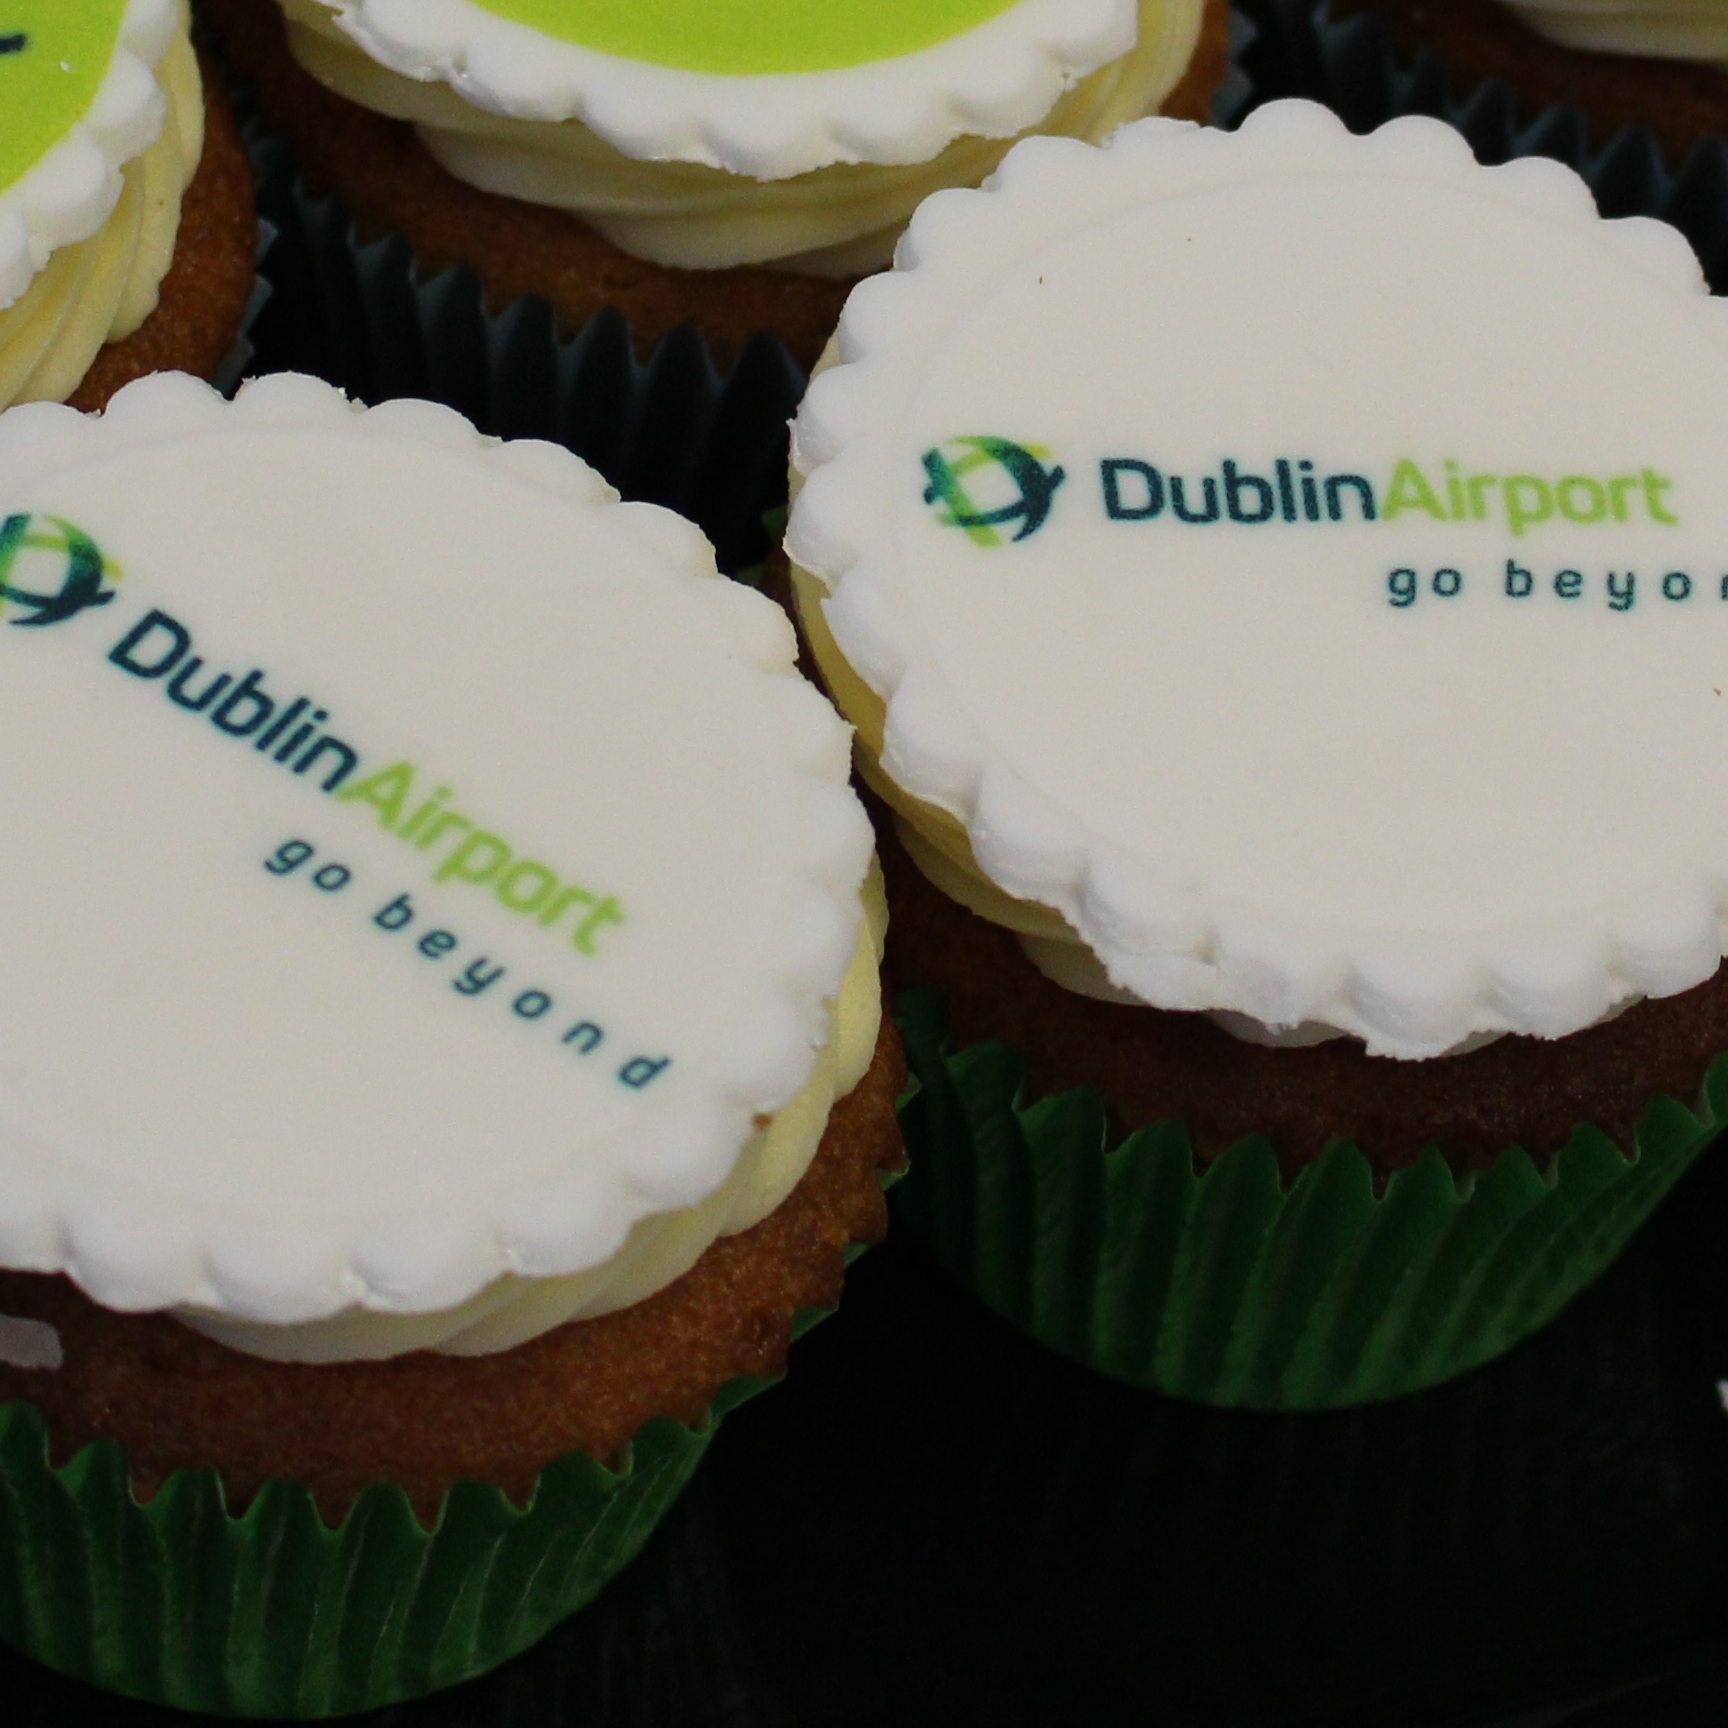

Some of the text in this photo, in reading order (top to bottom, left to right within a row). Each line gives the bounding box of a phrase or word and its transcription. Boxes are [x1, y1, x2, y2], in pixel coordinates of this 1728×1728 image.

[1098, 456, 1679, 538] DublinAirport
[1386, 565, 1464, 611] go
[104, 607, 625, 957] DublinAirport
[262, 836, 672, 1093] go beyond
